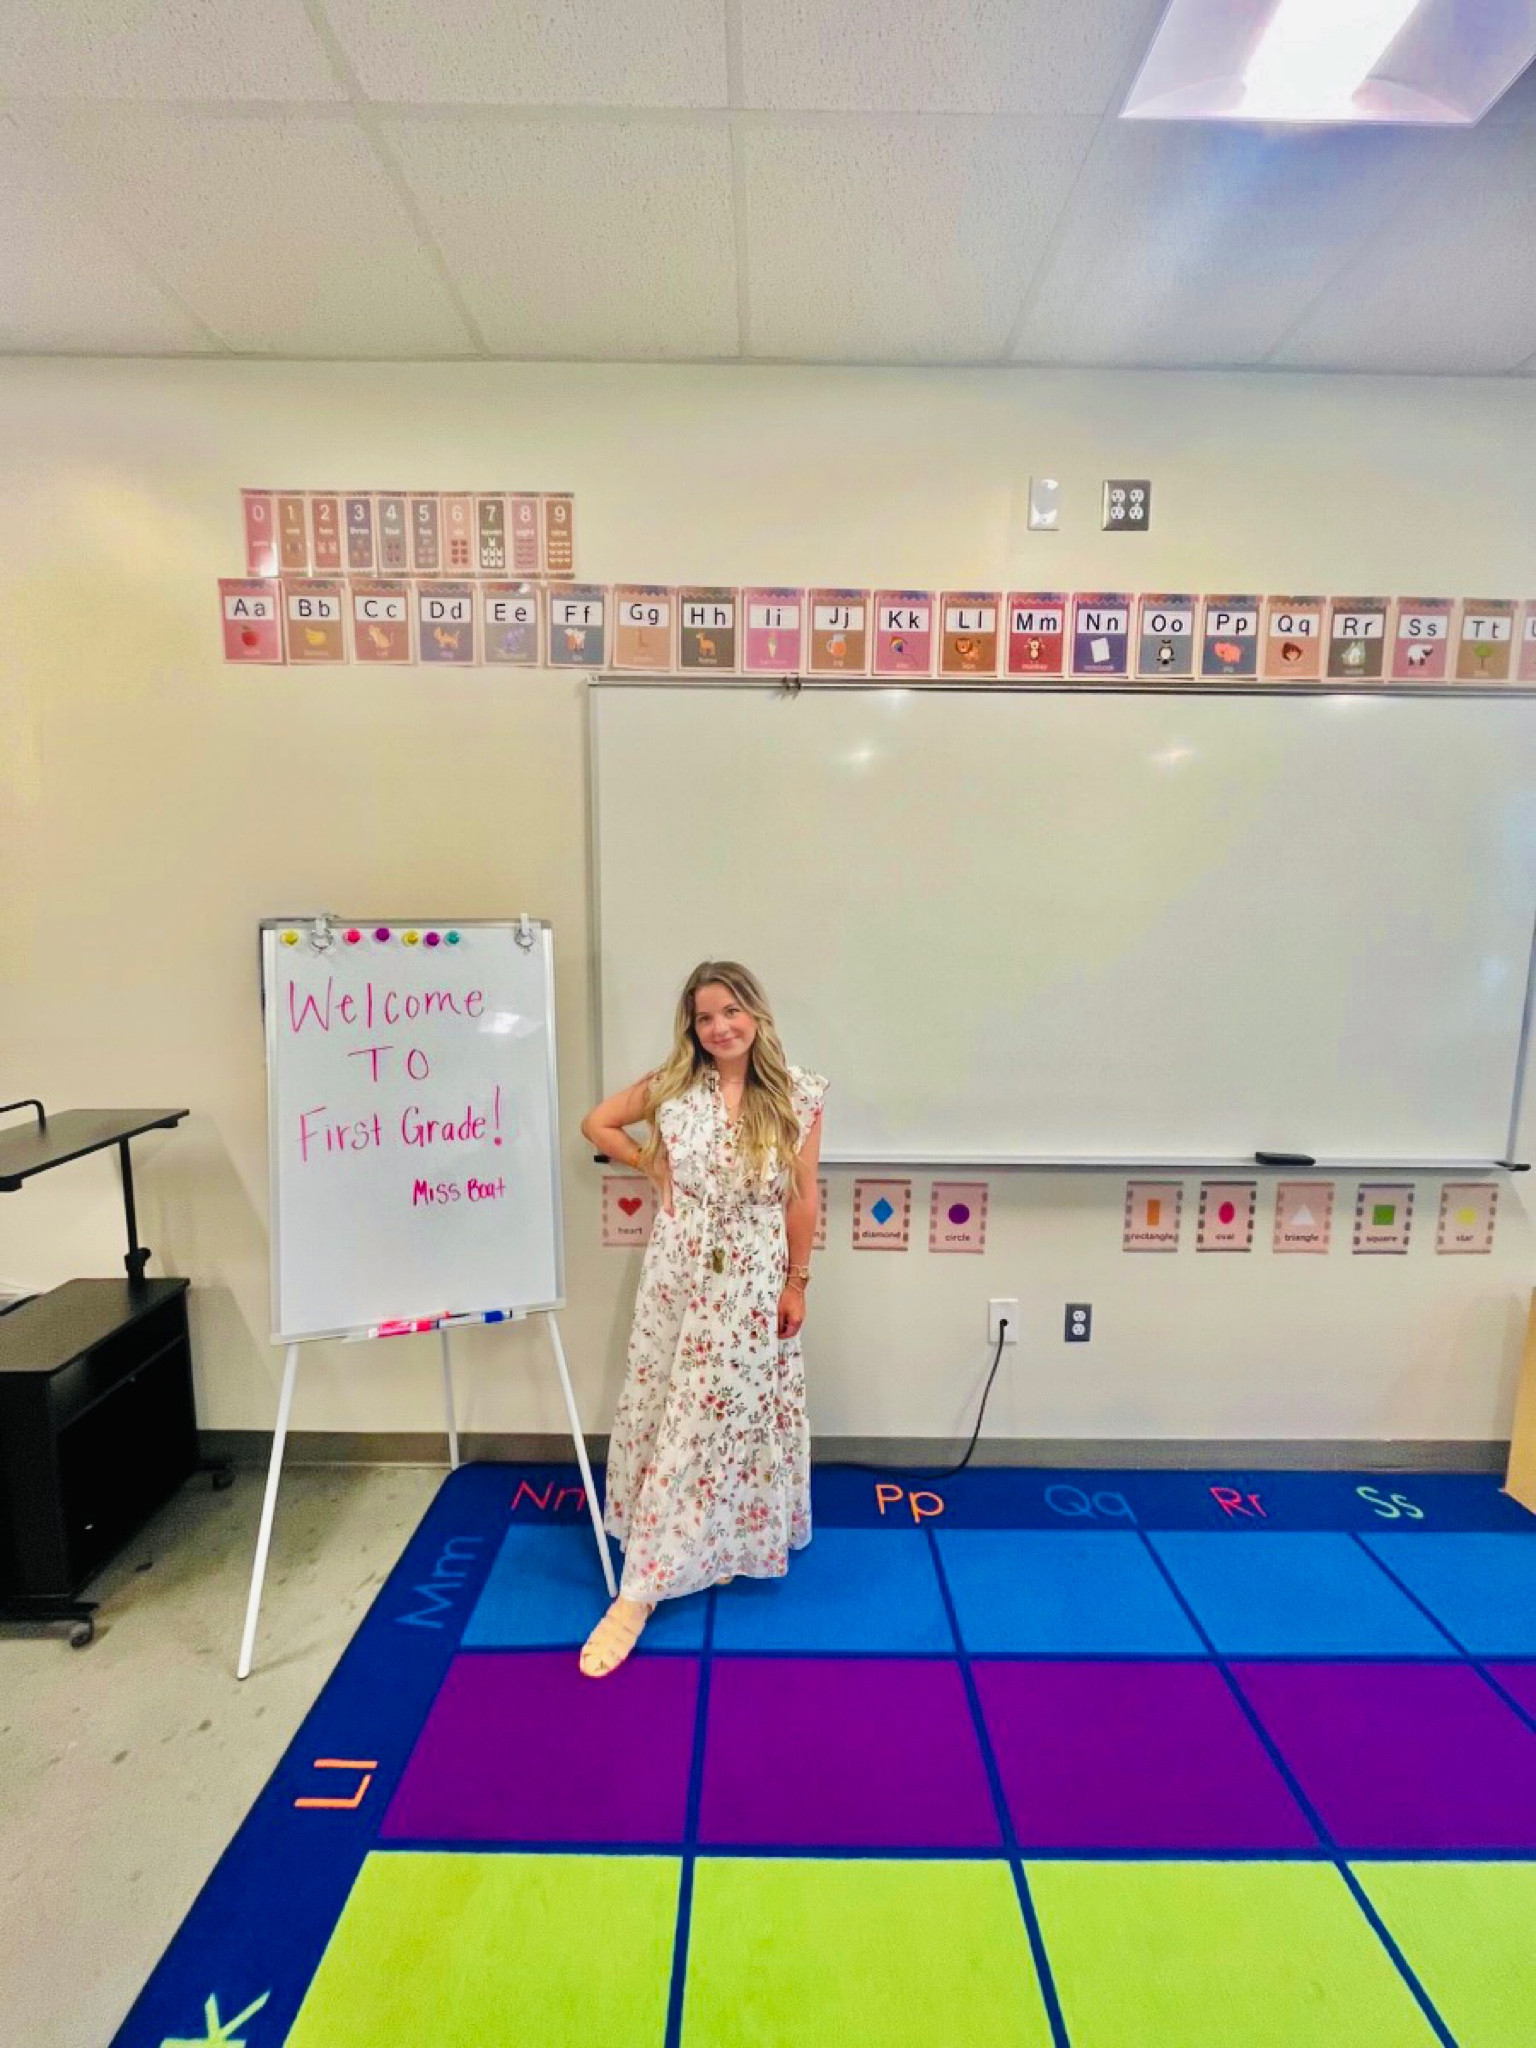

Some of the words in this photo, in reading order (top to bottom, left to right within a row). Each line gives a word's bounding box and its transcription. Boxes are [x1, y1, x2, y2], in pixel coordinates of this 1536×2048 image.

[252, 504, 265, 521] 0
[287, 504, 295, 520] 1
[320, 504, 330, 521] 2
[353, 504, 365, 521] 3
[385, 504, 397, 520] 4
[419, 504, 430, 522] 5
[451, 505, 463, 522] 6
[485, 505, 497, 522] 7
[519, 504, 532, 522] 8
[554, 506, 566, 523] 9
[287, 974, 487, 1034] Welcome
[296, 1105, 384, 1162] First
[400, 1084, 504, 1148] Grade!
[412, 1176, 462, 1207] Miss
[861, 1230, 902, 1239] diamond
[944, 1233, 971, 1242] circle
[1130, 1232, 1176, 1242] rectangle
[1284, 1232, 1320, 1243] triangle
[510, 1480, 587, 1512] Nn
[873, 1481, 945, 1525] Pp
[1043, 1483, 1138, 1525] Qq
[1207, 1484, 1271, 1520] Rr
[1354, 1485, 1425, 1521] Ss
[394, 1534, 484, 1630] Mm
